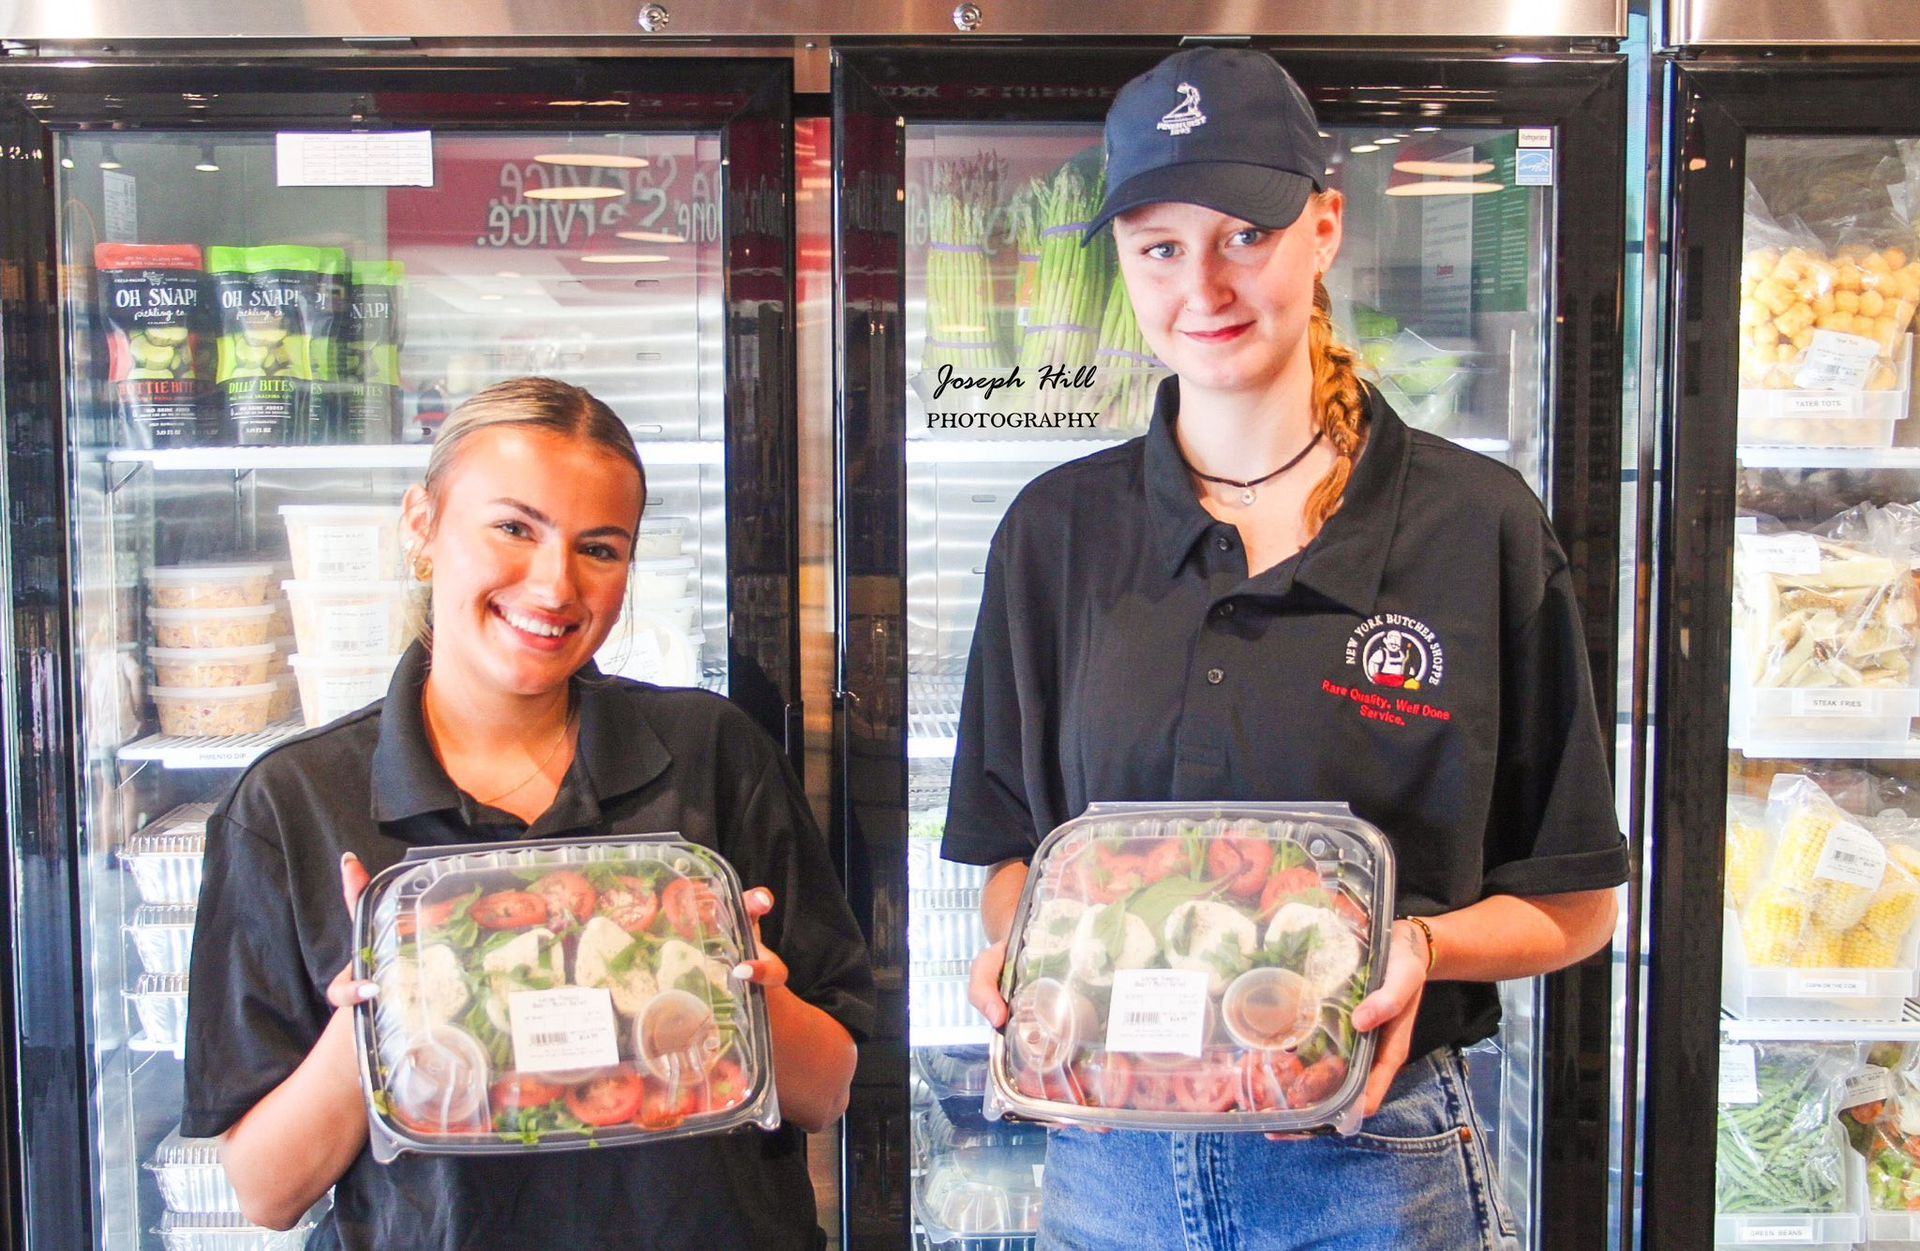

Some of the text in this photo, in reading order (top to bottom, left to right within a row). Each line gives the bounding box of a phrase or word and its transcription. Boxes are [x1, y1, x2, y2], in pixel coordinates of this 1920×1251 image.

[115, 287, 197, 308] OH SNAP!
[222, 291, 243, 309] OH
[249, 289, 300, 308] SNAP!
[350, 302, 389, 319] NAP!
[259, 379, 296, 393] BITES
[1345, 613, 1444, 687] NEW YORK BUTCHER SHOPPE
[1321, 680, 1348, 696] Rare
[1396, 699, 1420, 715] Well
[1422, 705, 1451, 720] Done
[1359, 704, 1406, 726] Service.
